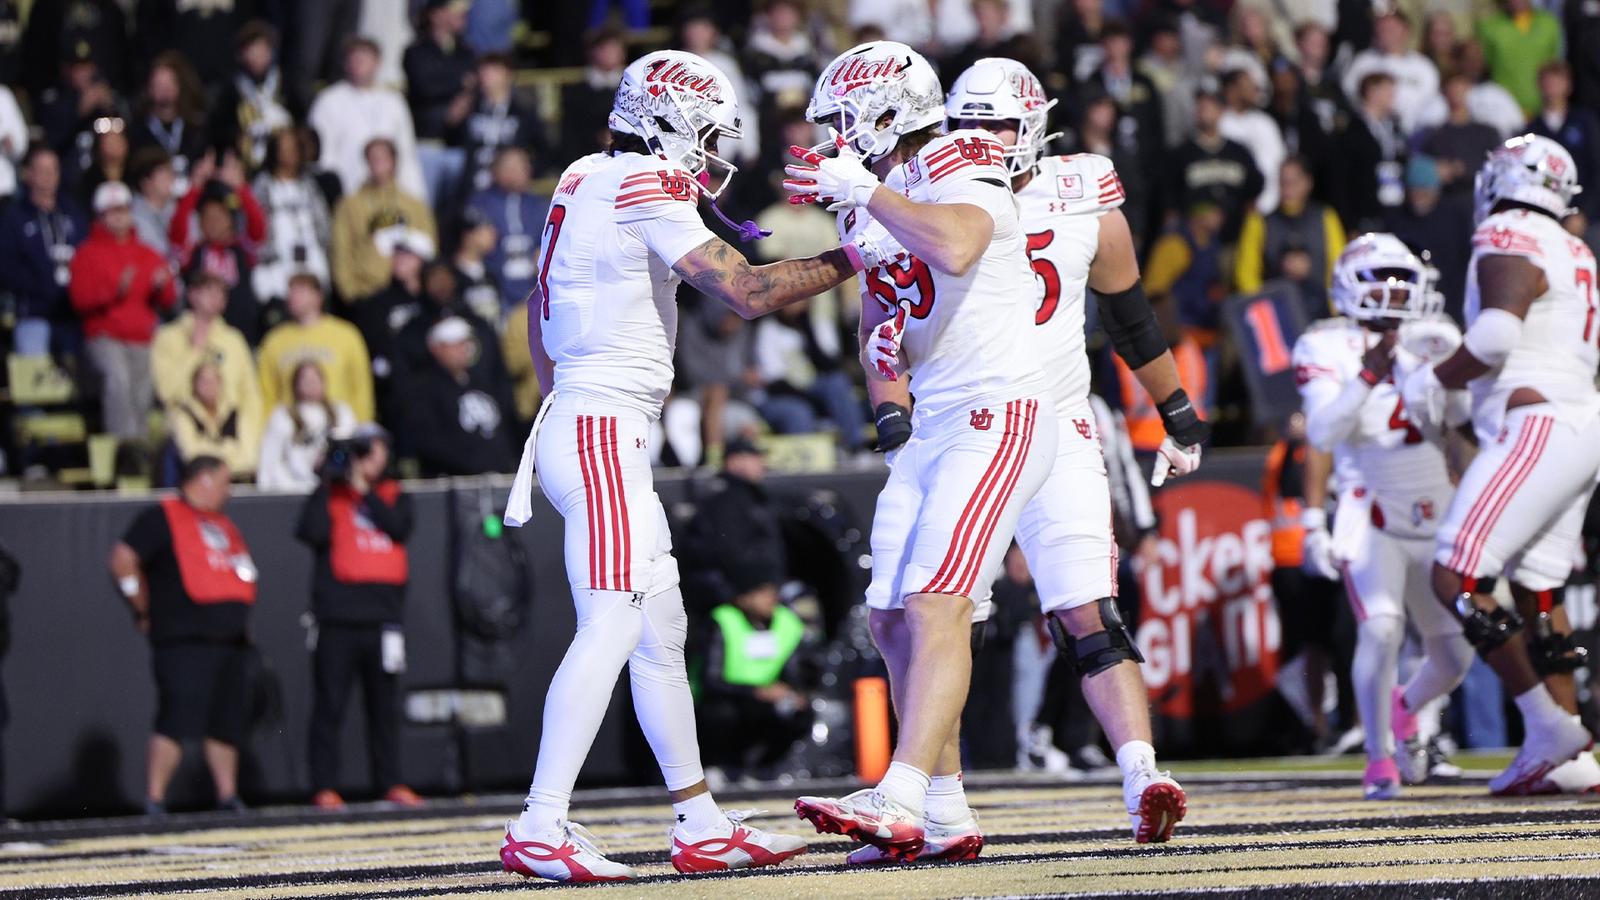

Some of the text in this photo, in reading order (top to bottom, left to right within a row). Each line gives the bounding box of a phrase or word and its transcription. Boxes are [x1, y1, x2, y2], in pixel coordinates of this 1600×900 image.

[645, 59, 721, 101] Utah
[830, 55, 908, 87] Utah
[540, 204, 566, 321] 7
[1025, 228, 1061, 326] 5
[1246, 300, 1291, 374] 1
